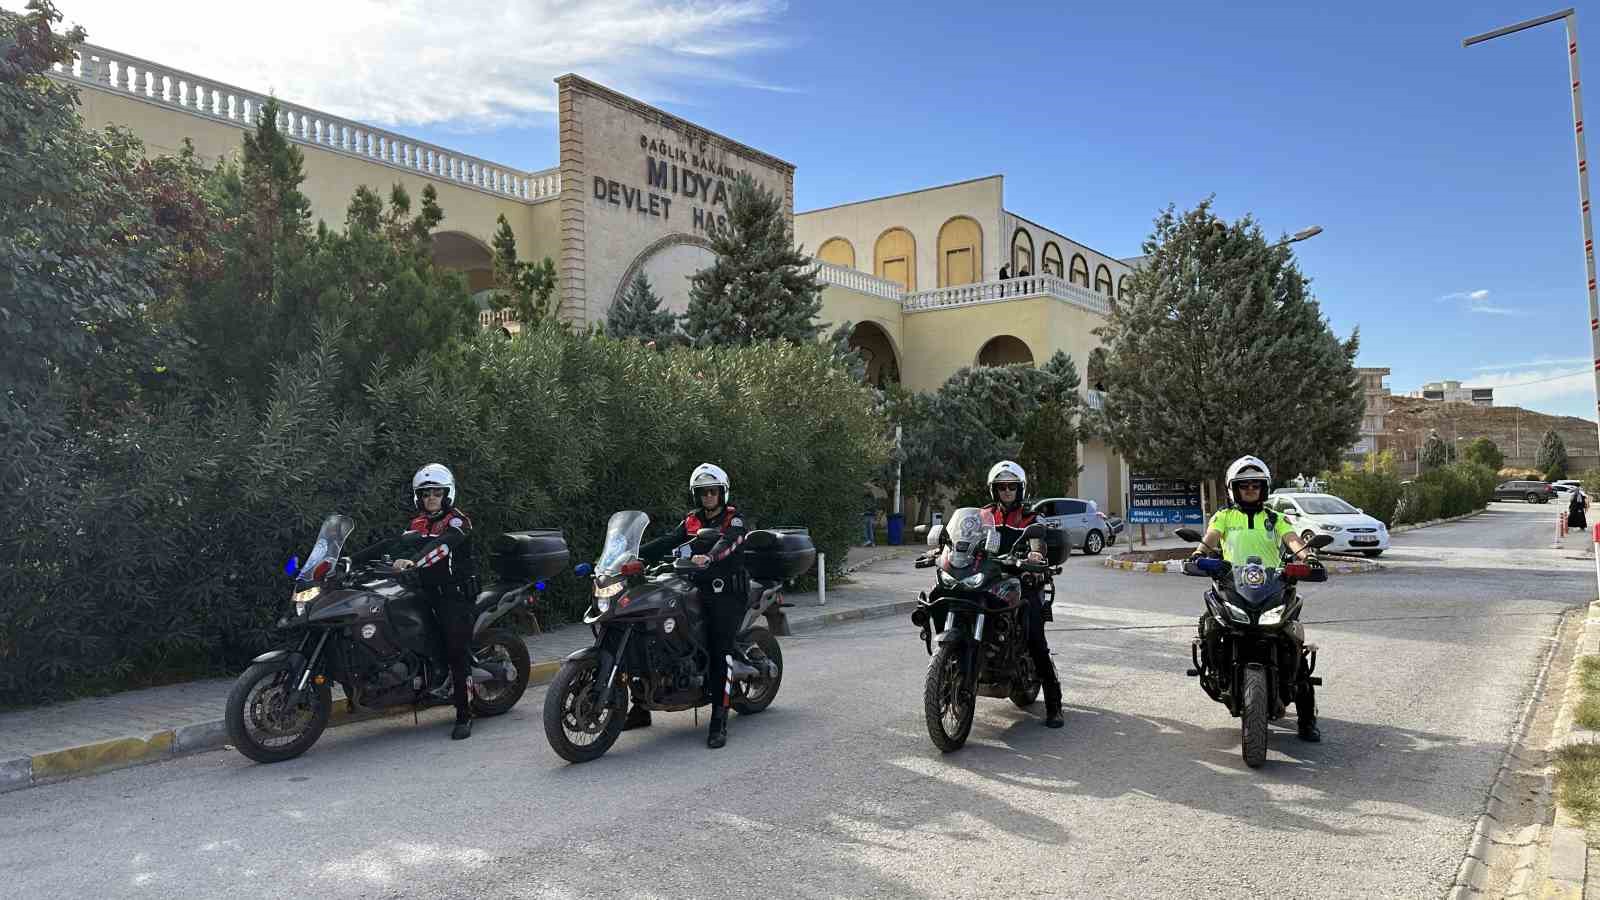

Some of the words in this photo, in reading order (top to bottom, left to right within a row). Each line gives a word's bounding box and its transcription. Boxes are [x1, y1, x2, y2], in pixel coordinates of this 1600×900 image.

[640, 135, 687, 163] SAĞLIK
[593, 175, 672, 220] DEVLET
[647, 156, 729, 206] MIDYA
